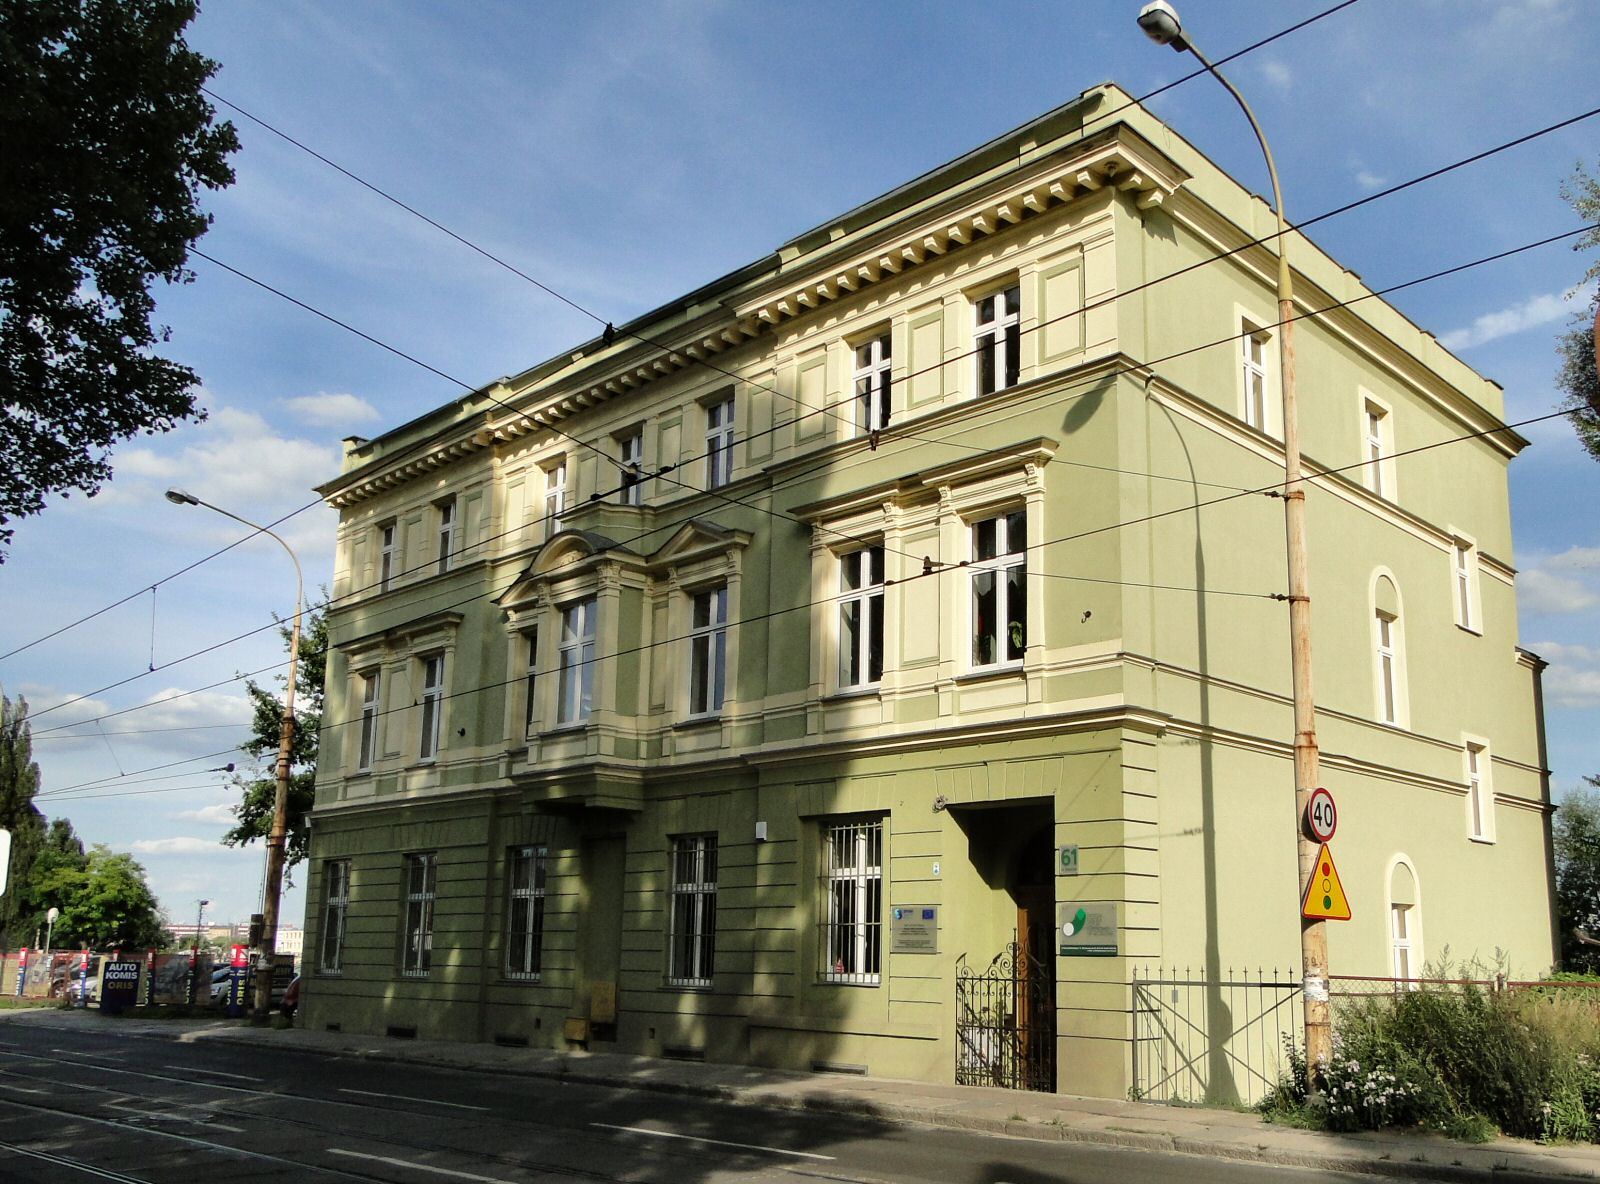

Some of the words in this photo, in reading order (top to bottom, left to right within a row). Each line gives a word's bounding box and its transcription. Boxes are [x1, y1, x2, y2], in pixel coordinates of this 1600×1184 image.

[1313, 801, 1333, 828] 40
[1061, 848, 1078, 866] 61
[108, 963, 137, 971] AUTO
[105, 971, 138, 980] KOMIS
[107, 981, 134, 990] ORIS
[236, 979, 246, 1006] ORIS
